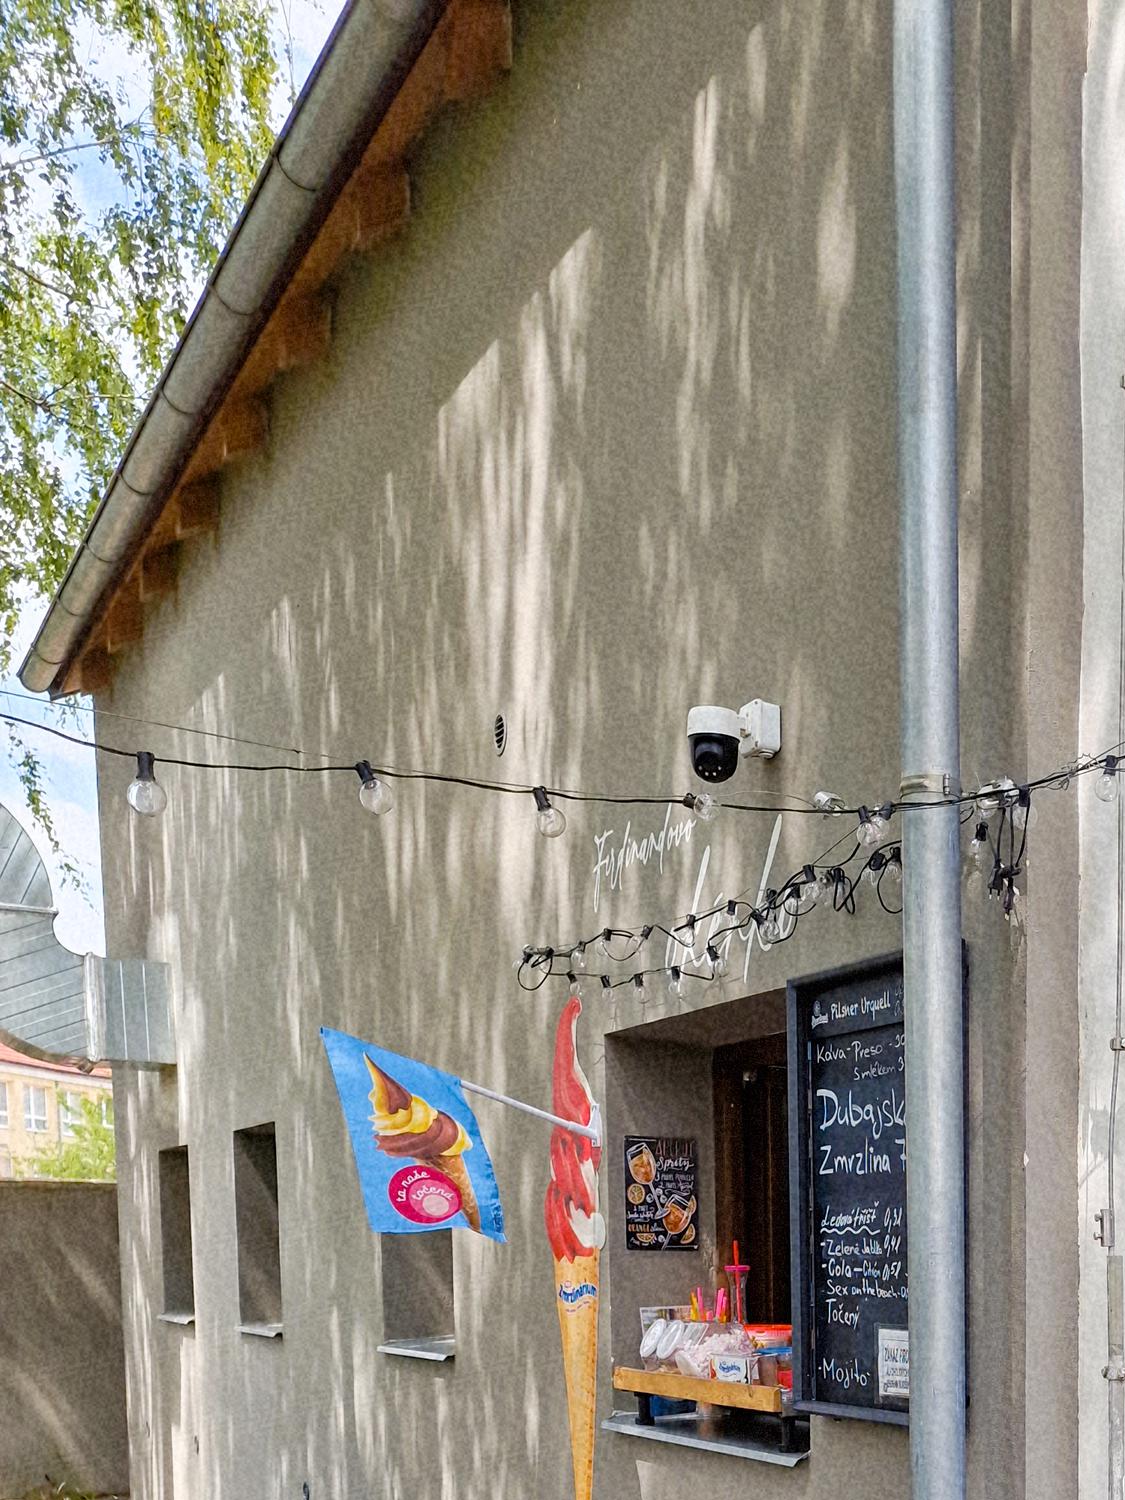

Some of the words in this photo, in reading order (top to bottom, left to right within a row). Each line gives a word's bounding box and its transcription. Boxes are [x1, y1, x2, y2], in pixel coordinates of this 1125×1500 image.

[830, 1001, 859, 1021] Pilsner
[860, 991, 891, 1021] Urquell
[819, 1136, 892, 1175] Zmrzlina
